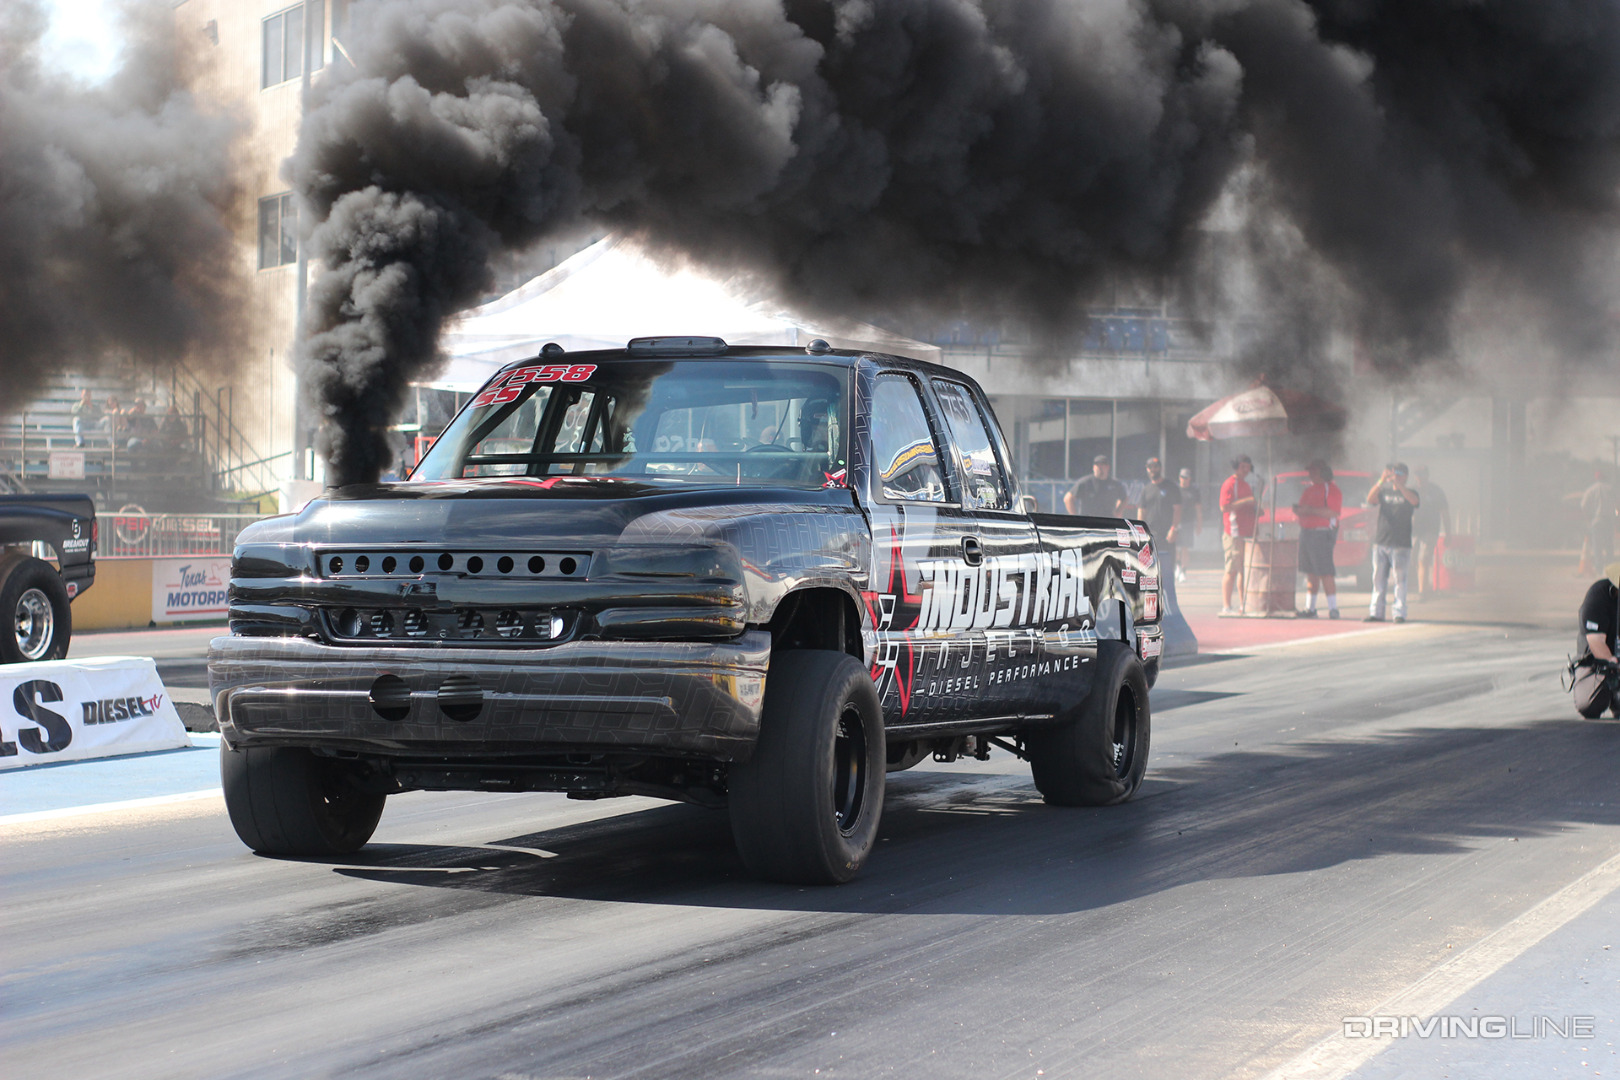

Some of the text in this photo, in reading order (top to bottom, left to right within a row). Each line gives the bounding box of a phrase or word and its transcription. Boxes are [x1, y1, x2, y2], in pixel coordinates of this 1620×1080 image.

[487, 364, 598, 390] 7558
[468, 383, 526, 410] SS
[179, 564, 207, 590] Texas
[928, 656, 1079, 697] DIESEL PERFORMANCE
